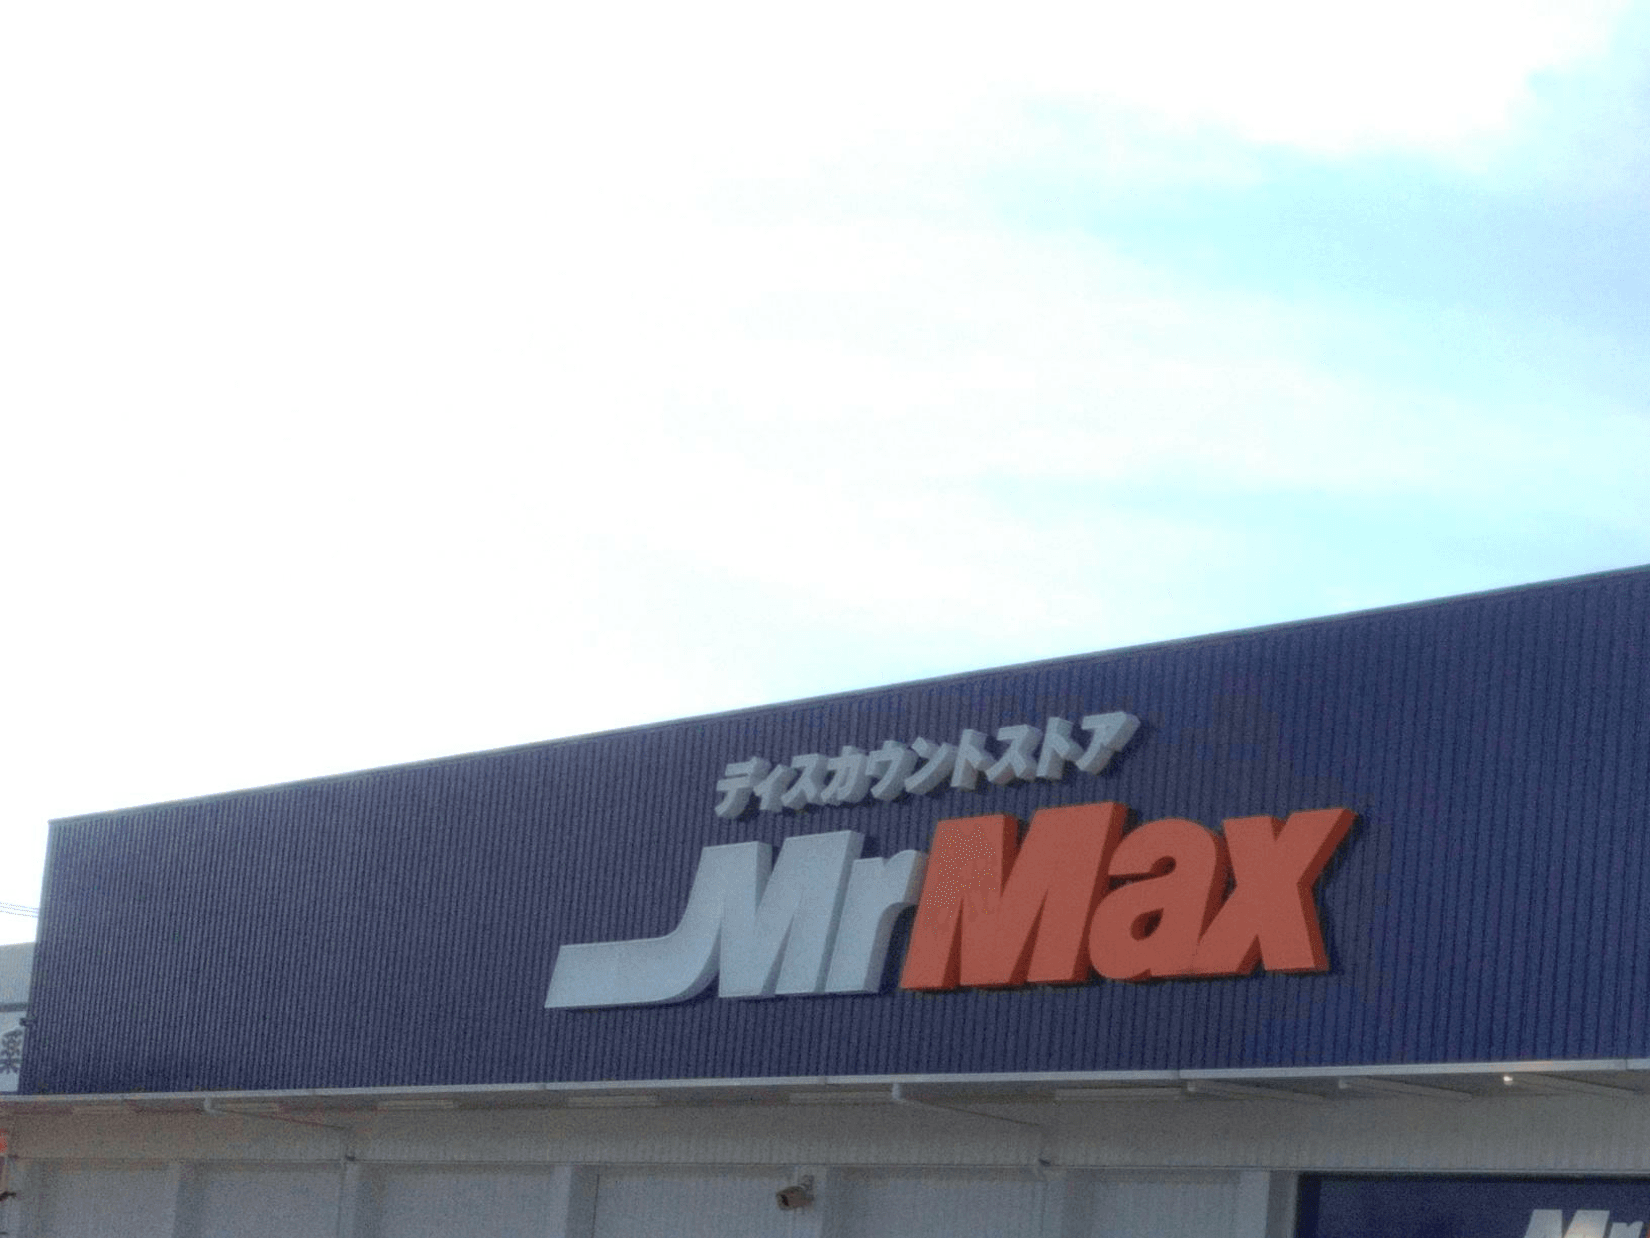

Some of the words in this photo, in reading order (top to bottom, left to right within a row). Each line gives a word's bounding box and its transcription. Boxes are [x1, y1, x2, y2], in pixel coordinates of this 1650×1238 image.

[715, 711, 1140, 820] ディスカウントストア
[544, 802, 1357, 1009] MrMax
